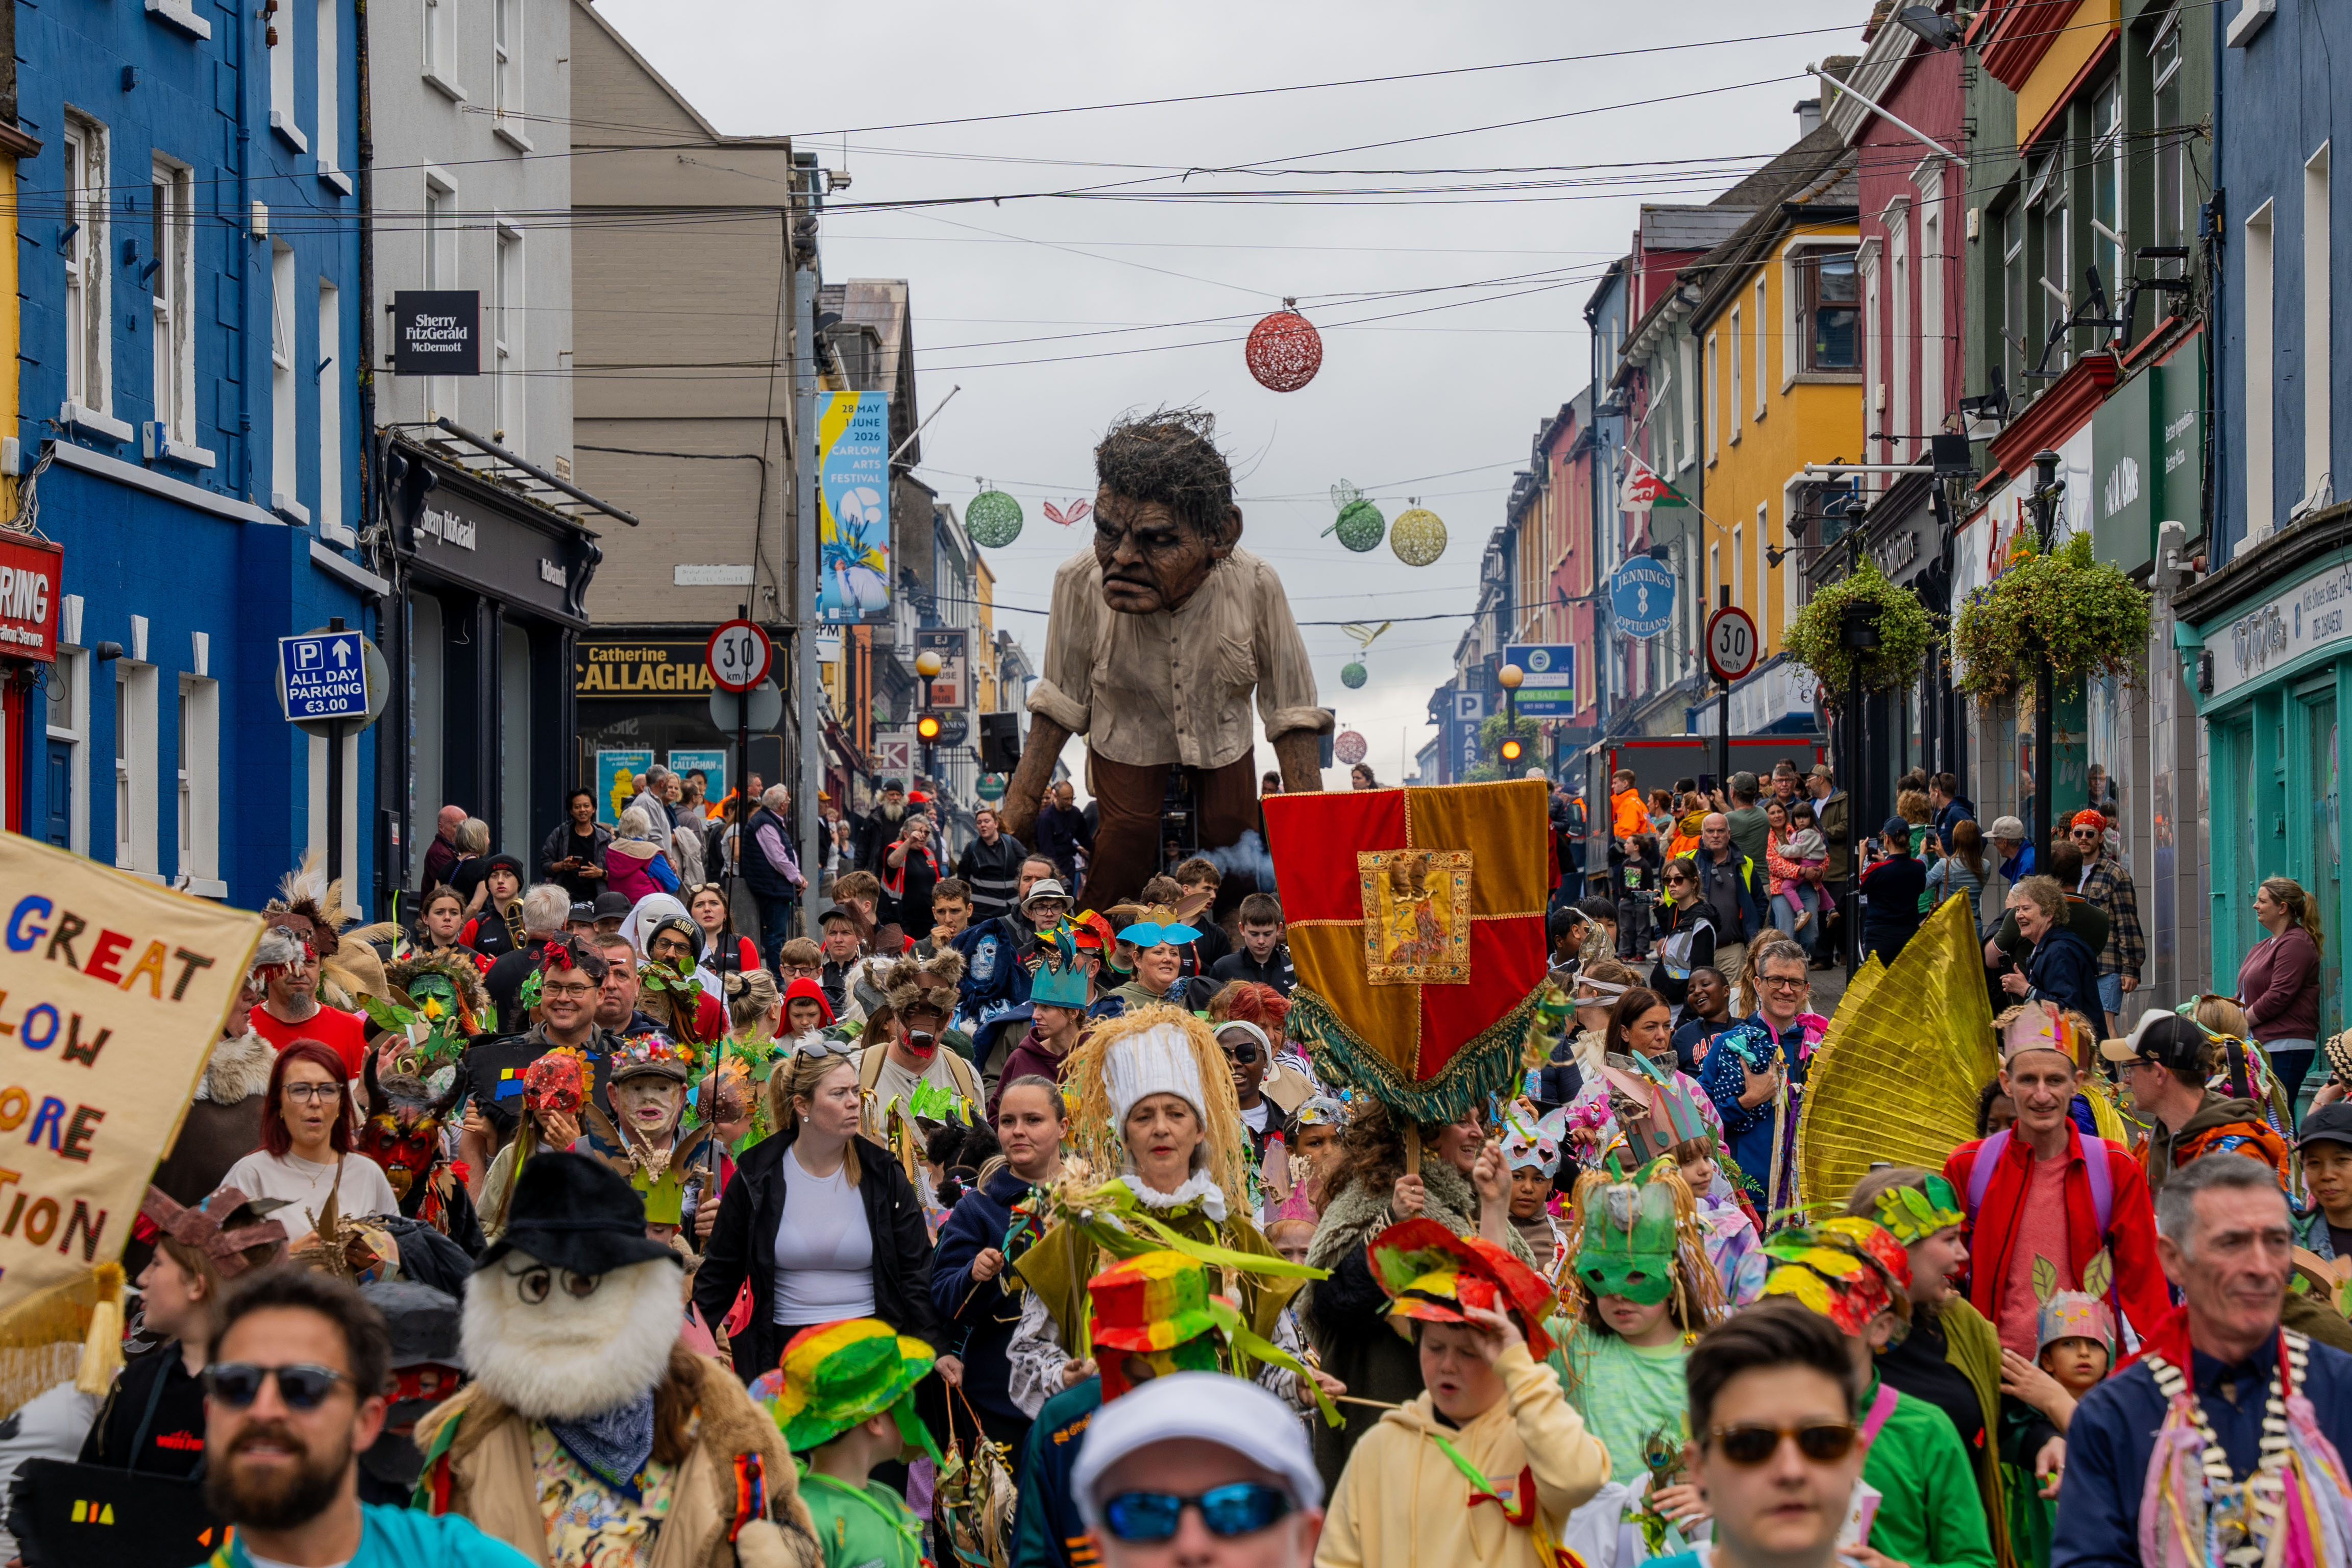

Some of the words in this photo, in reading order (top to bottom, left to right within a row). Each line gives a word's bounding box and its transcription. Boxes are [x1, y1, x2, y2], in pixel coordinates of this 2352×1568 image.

[415, 314, 457, 330] Sherry
[406, 327, 468, 339] FitzGerald
[412, 342, 461, 352] McDermott
[842, 405, 854, 413] 28
[857, 405, 880, 413] MAY
[846, 419, 849, 427] 1
[852, 419, 880, 427] JUNE
[854, 432, 880, 441] 2026
[832, 446, 880, 455] CARLOW
[852, 460, 881, 469] ARTS
[831, 474, 880, 483] FESTIVAL
[421, 504, 443, 546] Sherry
[443, 510, 476, 551] FitzGerald
[1885, 529, 1914, 579] Solicitors
[542, 558, 566, 588] McDermott
[1616, 569, 1671, 592] JENNINGS
[2303, 589, 2312, 613] Kids
[2312, 586, 2325, 609] Shoes
[2326, 580, 2338, 603] Sizes
[2339, 572, 2352, 598] 17-4
[1619, 616, 1667, 632] OPTICIANS
[0, 624, 17, 643] ation
[18, 626, 43, 648] Service
[935, 635, 948, 645] EJ
[1720, 623, 1746, 656] 30
[300, 644, 317, 668] P
[589, 647, 667, 662] Catherine
[723, 638, 753, 668] 30
[1721, 657, 1741, 670] km/h
[290, 672, 322, 685] ALL
[326, 669, 358, 682] DAY
[726, 671, 751, 682] km/h
[289, 682, 361, 700] PARKING
[932, 695, 950, 703] PUB
[305, 698, 348, 713] €3.00
[1461, 697, 1477, 716] P
[672, 761, 716, 770] CALLAGHAN
[679, 921, 694, 937] NBA
[6, 895, 215, 1001] GREAT
